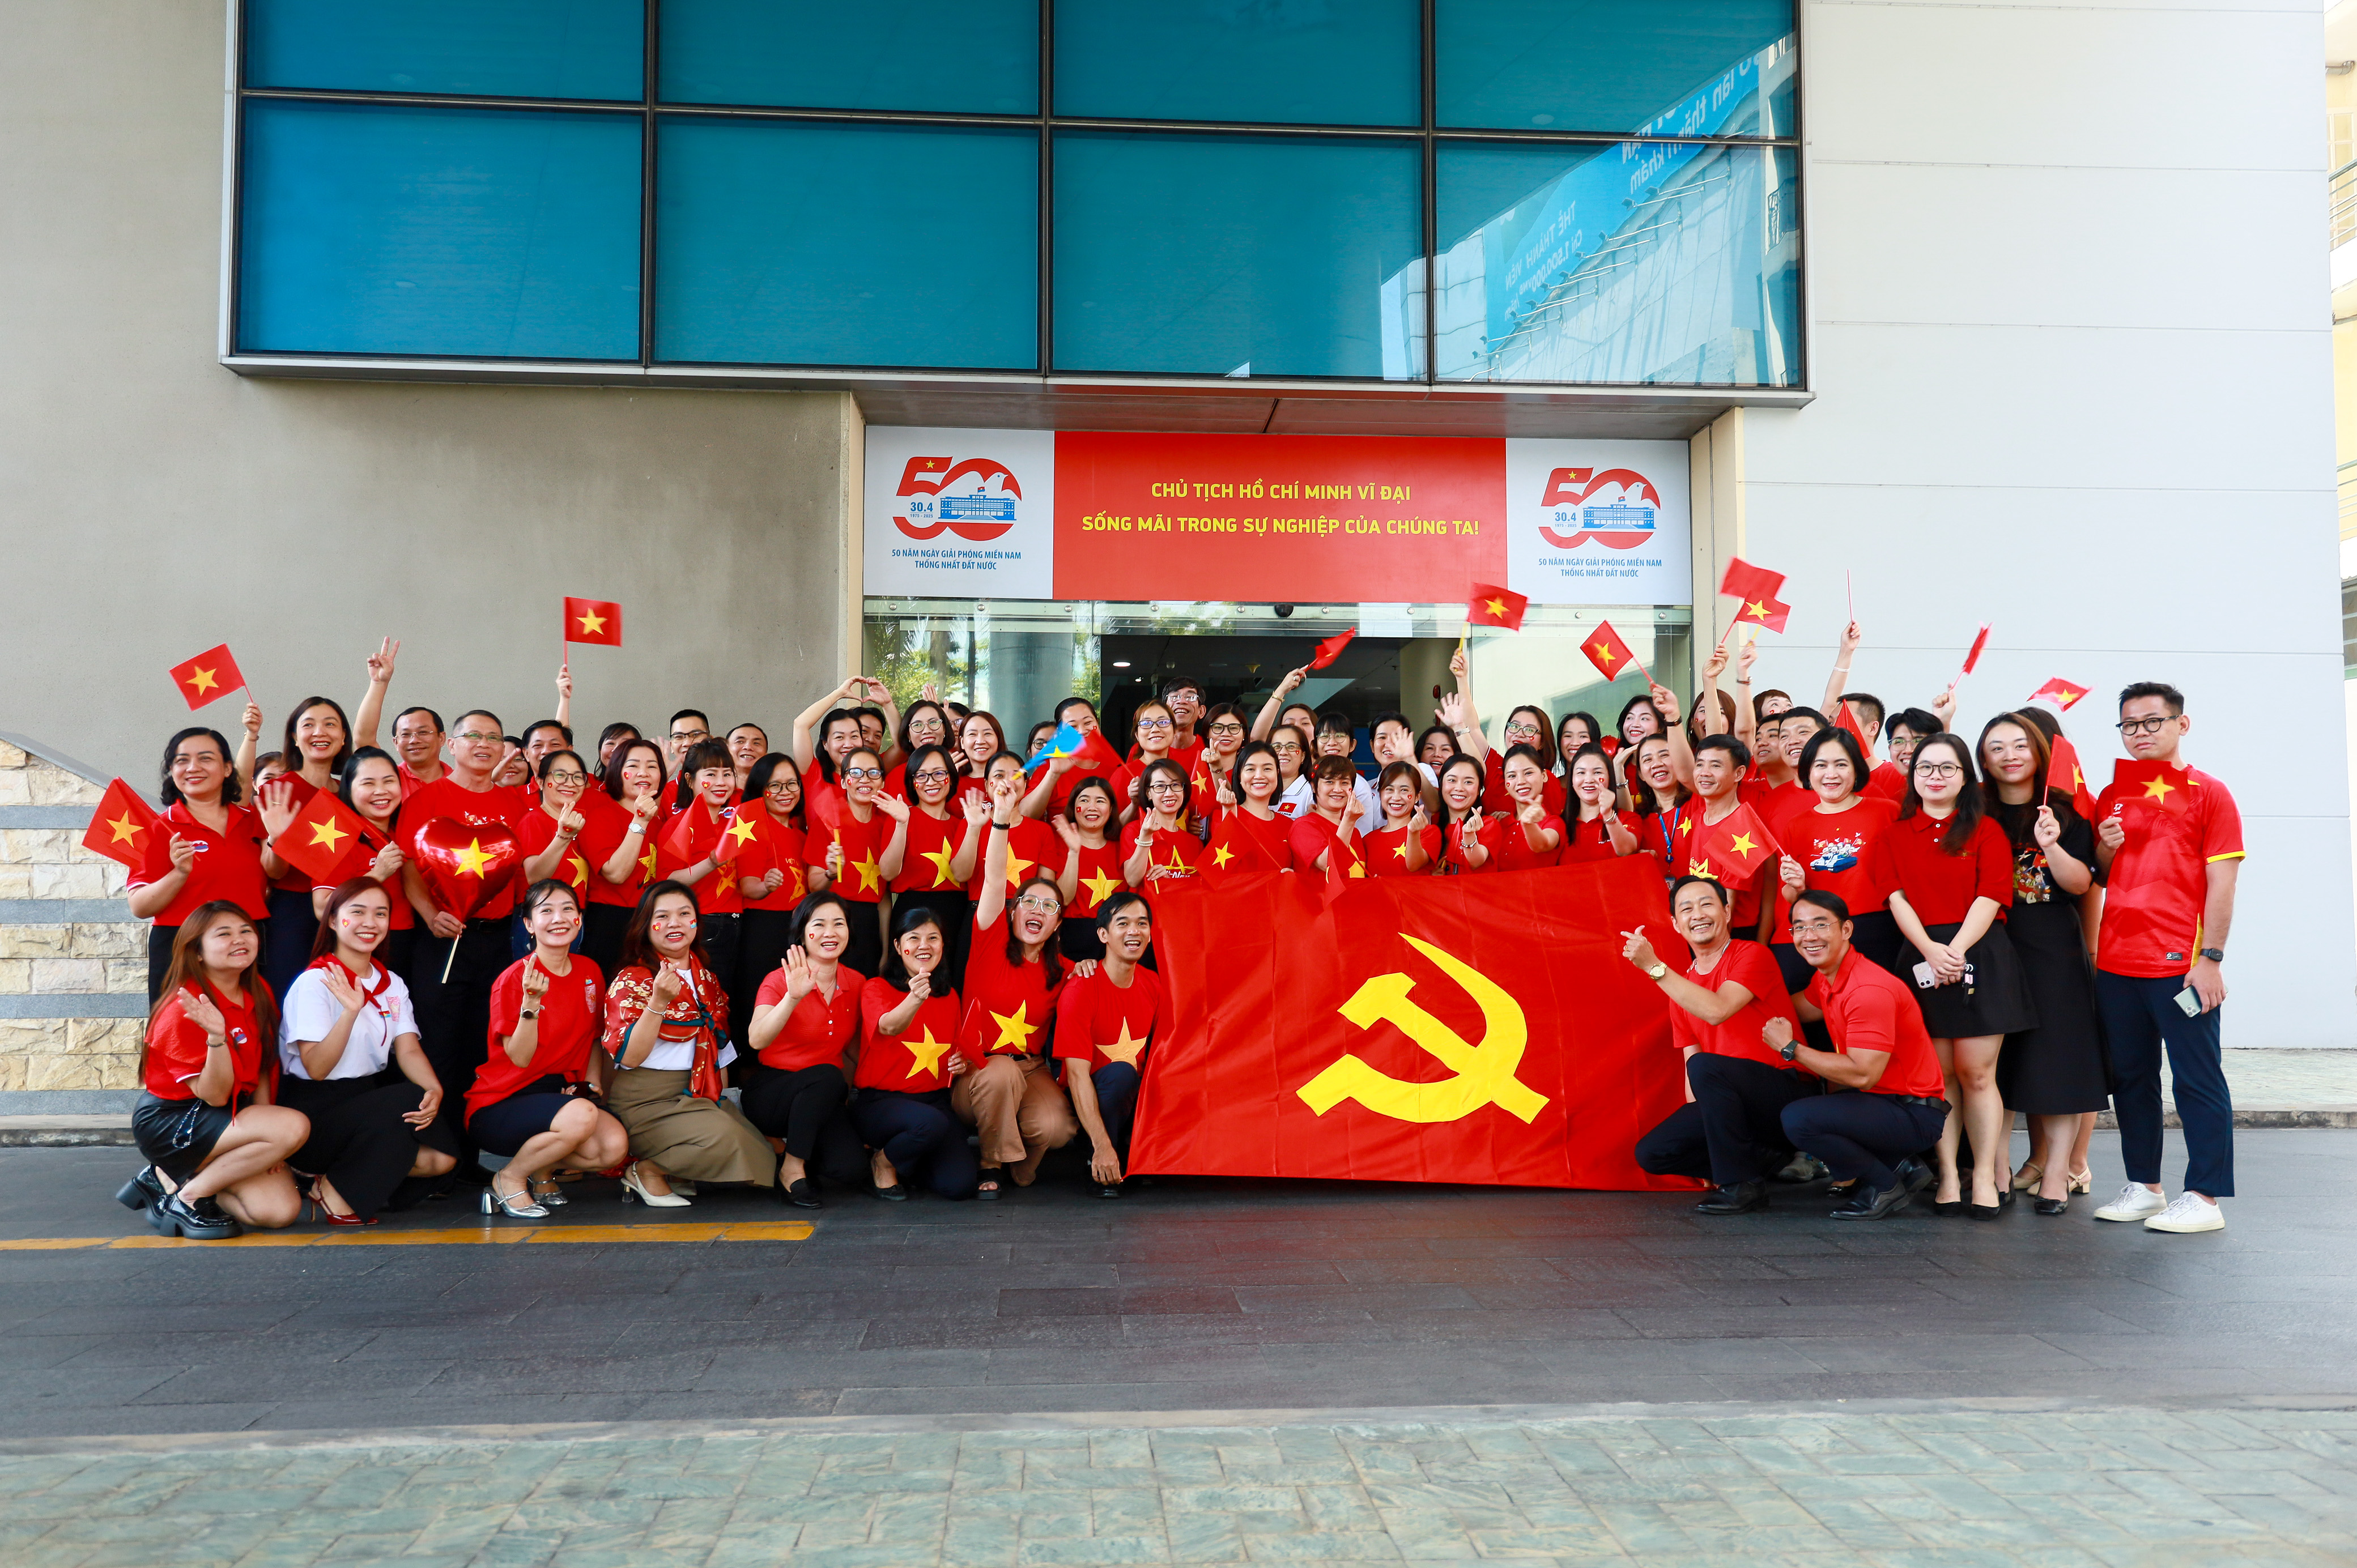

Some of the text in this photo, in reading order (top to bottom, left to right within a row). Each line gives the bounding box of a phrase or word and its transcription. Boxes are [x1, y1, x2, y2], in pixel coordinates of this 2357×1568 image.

[1152, 478, 1411, 504] CHỦ TỊCH HỒ CHÍ MINH VĨ ĐẠI
[910, 502, 933, 512] 30.4
[1555, 512, 1577, 522] 30.4
[1082, 510, 1479, 538] SỐNG MÃI TRONG SỰ NGHIỆP CỦA CHÚNG TA!
[903, 548, 919, 557] NĂM
[921, 548, 940, 558] NGÀY
[941, 548, 956, 558] GIẢI
[958, 549, 983, 559] PHÓNG
[1005, 551, 1022, 560] NAM
[915, 559, 997, 570] THỐNG NHẤT ĐẤT NƯỚC
[1548, 557, 1564, 566] NĂM
[1566, 557, 1584, 566] NGÀY
[1586, 557, 1599, 566] GIẢI
[1601, 557, 1625, 566] PHÓNG
[1560, 567, 1639, 577] THỐNG NHẤT ĐẤT NƯỚC
